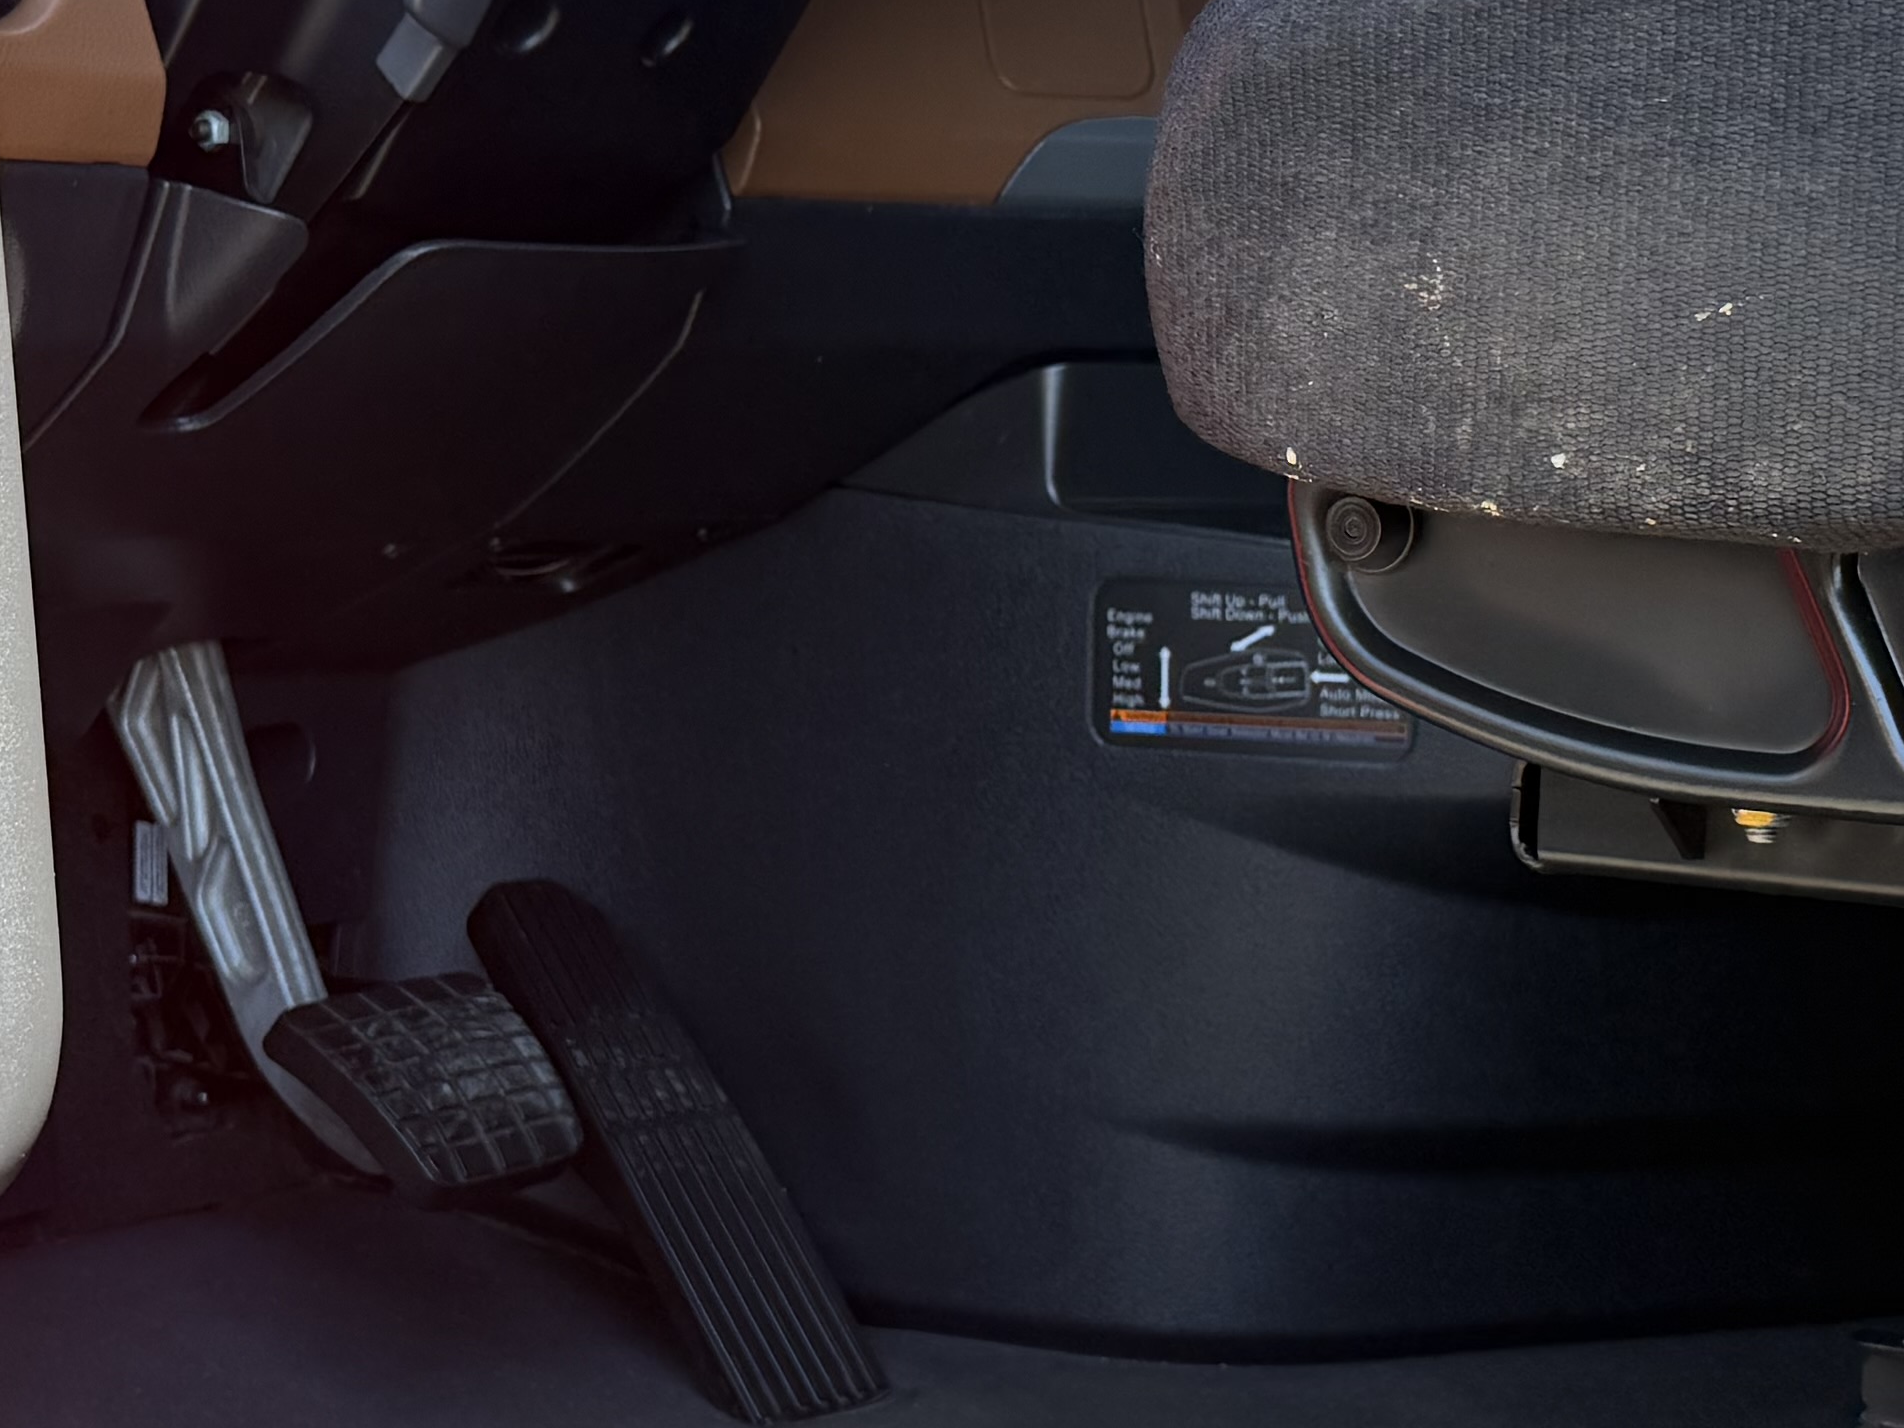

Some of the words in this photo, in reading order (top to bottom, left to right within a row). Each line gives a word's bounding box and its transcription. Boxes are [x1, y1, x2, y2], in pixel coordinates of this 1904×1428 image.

[1191, 591, 1222, 606] Shift
[1225, 592, 1246, 608] Up
[1259, 593, 1285, 609] Pull
[1107, 607, 1153, 626] Engine
[1191, 606, 1222, 620] Shift
[1225, 607, 1264, 621] Down
[1107, 624, 1146, 640] Brake
[1112, 641, 1135, 656] Off
[1112, 660, 1140, 673] Low
[1112, 676, 1142, 690] Med
[1112, 693, 1145, 708] High
[1319, 688, 1352, 701] Auto
[1319, 703, 1355, 718] Short
